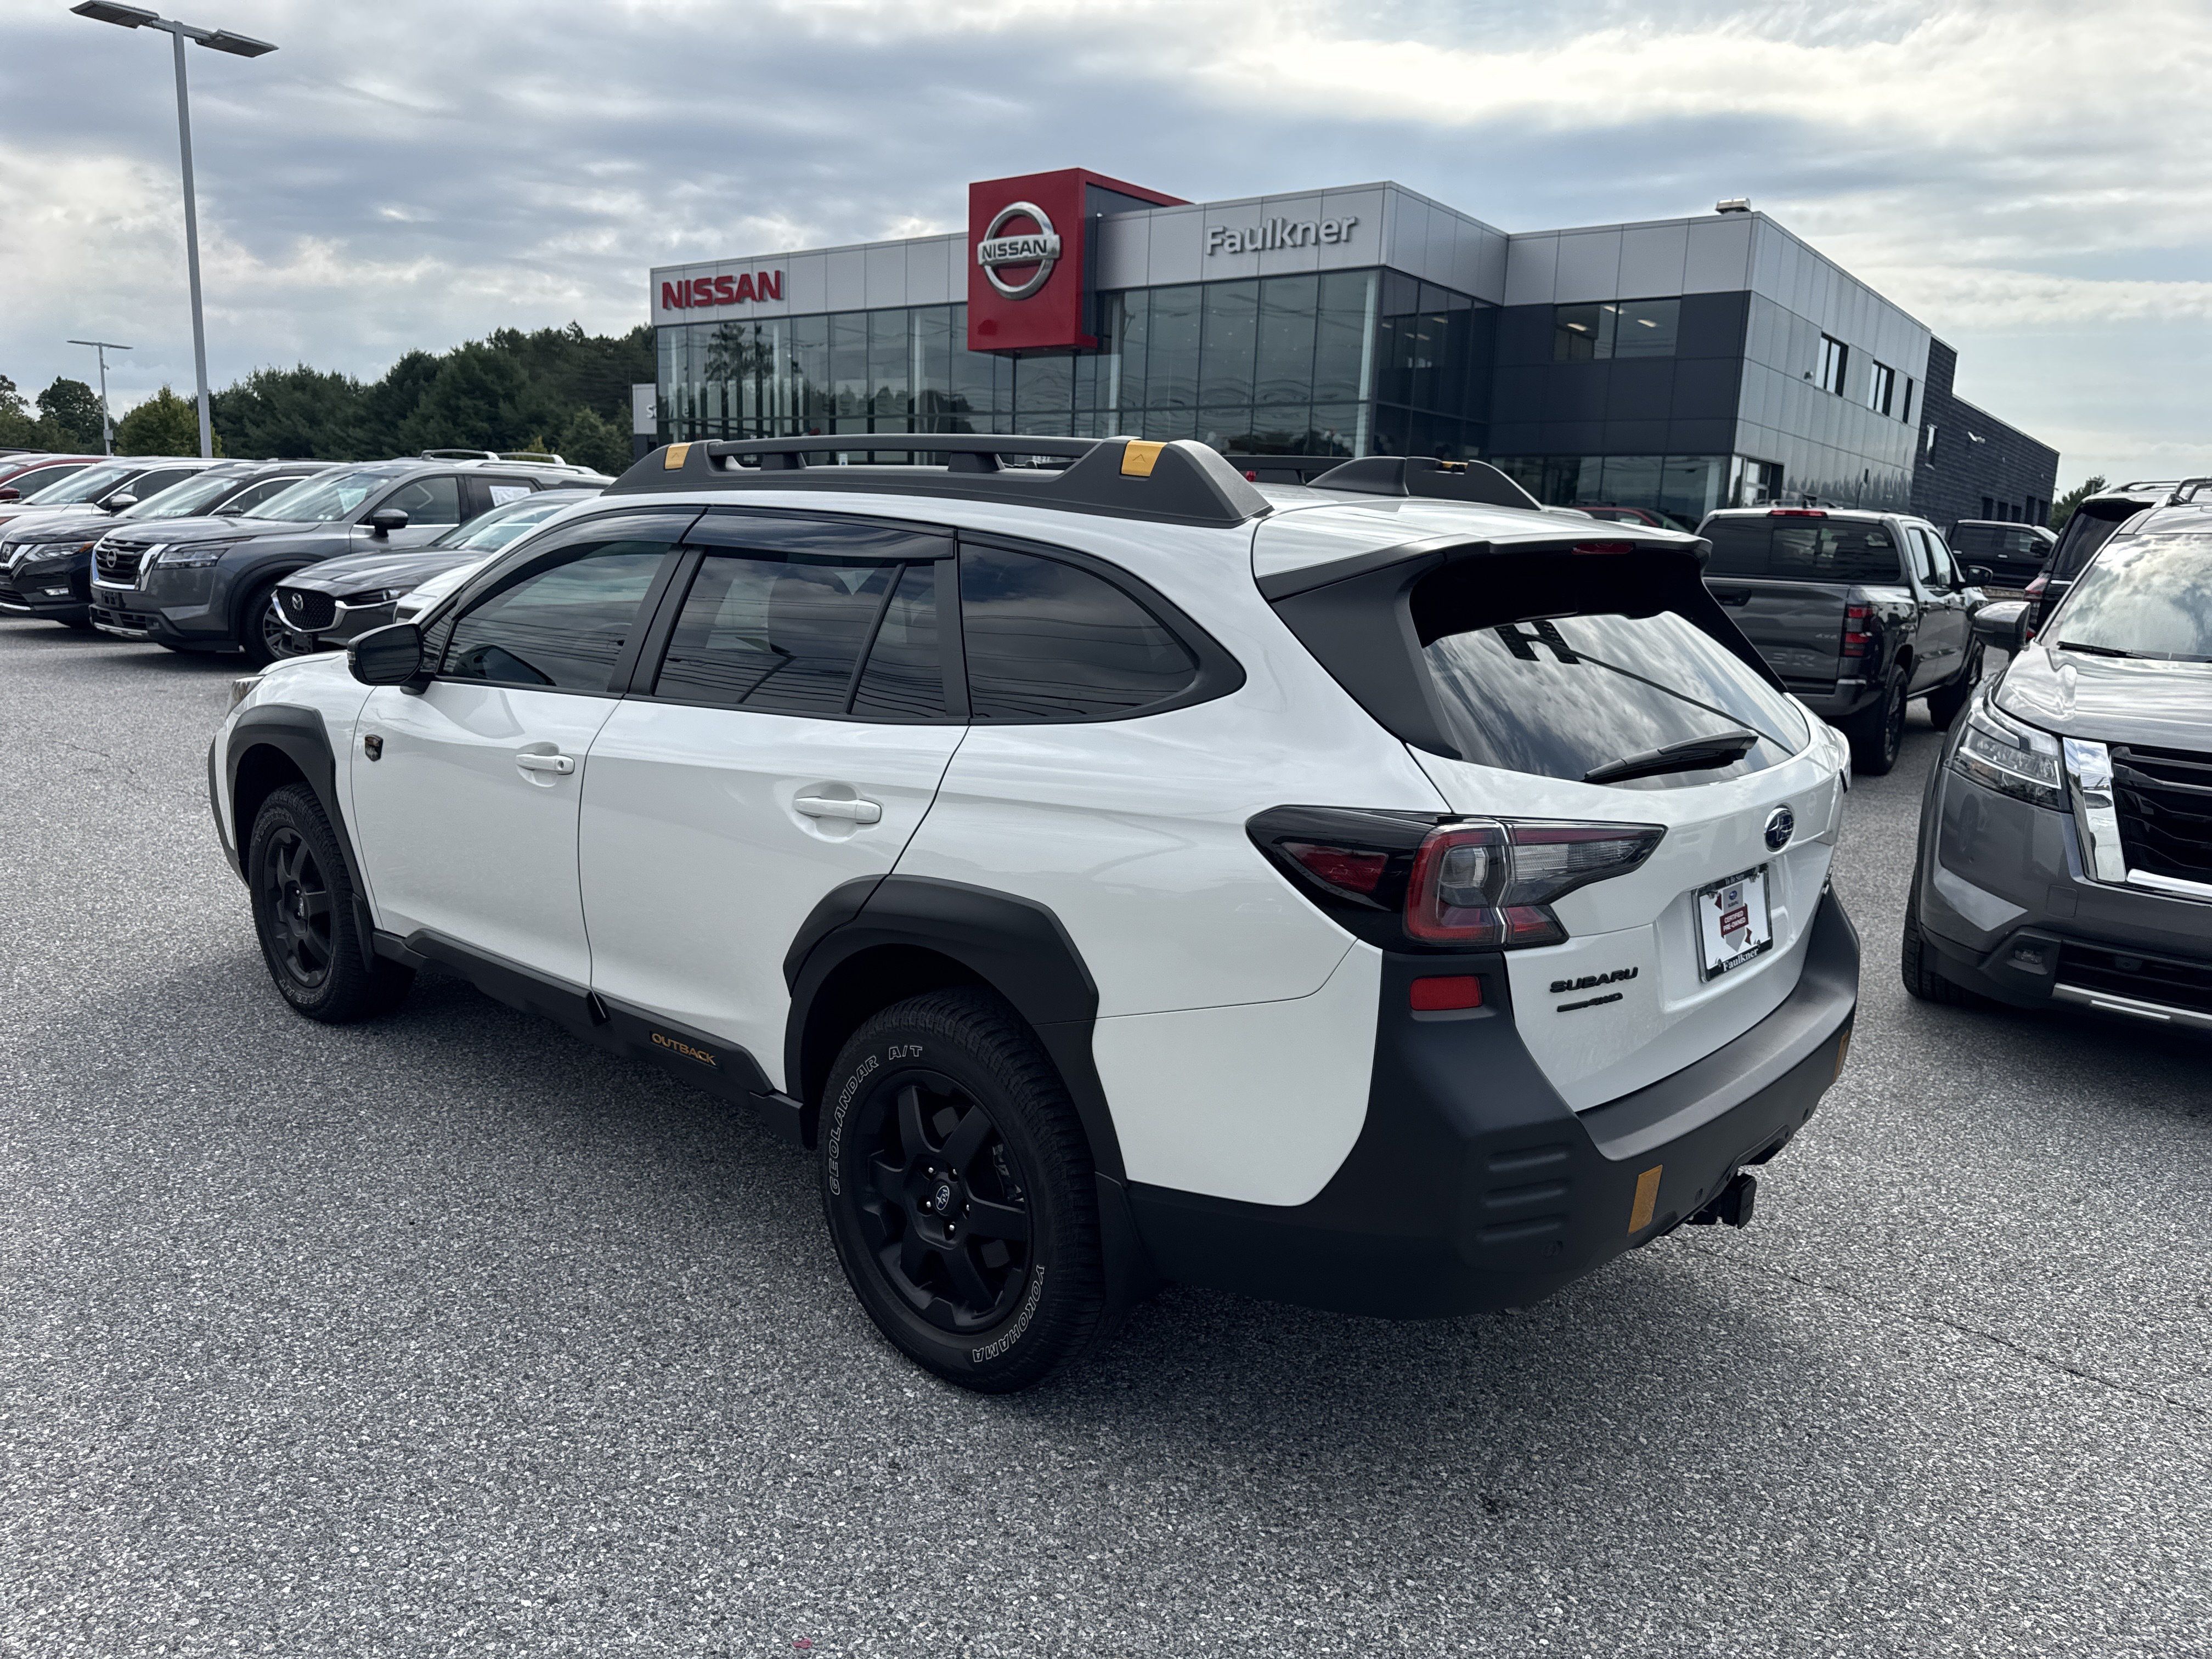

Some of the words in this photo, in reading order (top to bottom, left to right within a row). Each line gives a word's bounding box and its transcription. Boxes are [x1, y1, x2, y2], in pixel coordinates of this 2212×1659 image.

[982, 239, 1047, 259] NISSAN
[1206, 217, 1359, 256] Faulkner
[662, 270, 784, 309] NISSAN
[1723, 917, 1746, 932] PRE-OWNED
[1724, 910, 1743, 924] CERTIFIED
[1723, 947, 1759, 971] Faulkner
[1550, 967, 1639, 992] SUBARU
[651, 1033, 716, 1065] OUTBACK
[829, 1056, 879, 1195] GEOLANDAR
[888, 1045, 923, 1060] A/T
[972, 1265, 1045, 1363] YOKOHAMA
